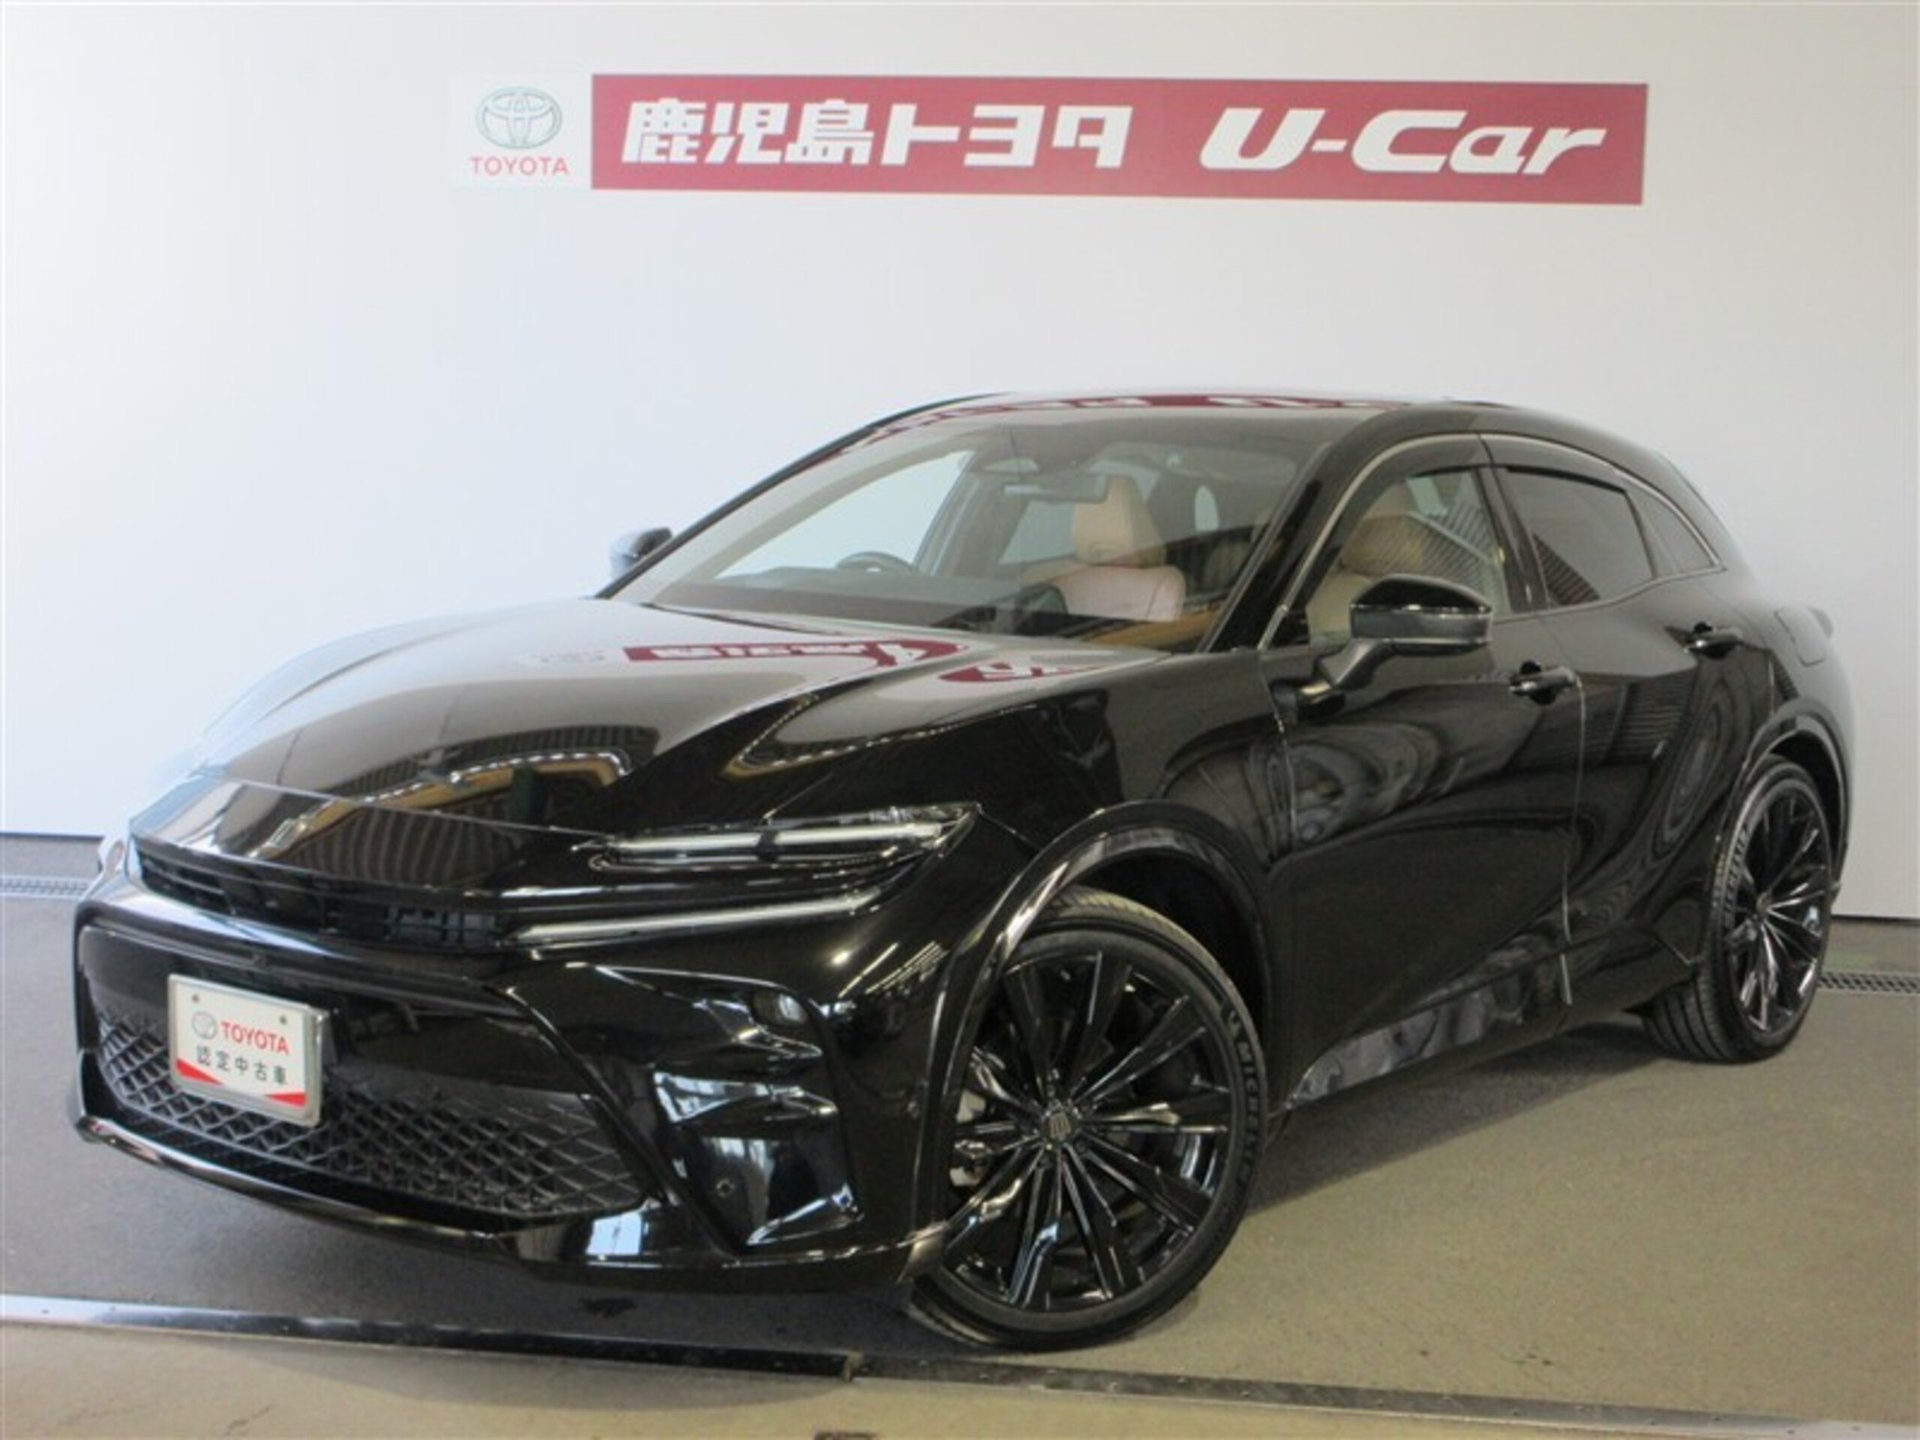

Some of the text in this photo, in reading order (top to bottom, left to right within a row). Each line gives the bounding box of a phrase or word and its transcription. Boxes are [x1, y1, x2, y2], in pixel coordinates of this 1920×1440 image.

[622, 97, 1607, 175] 鹿児島トヨタ U-Car
[470, 156, 570, 176] TOYOTA
[220, 1019, 290, 1055] TOYOTA
[196, 1045, 289, 1085] 認定中古車
[1236, 1041, 1260, 1183] MICHELIN
